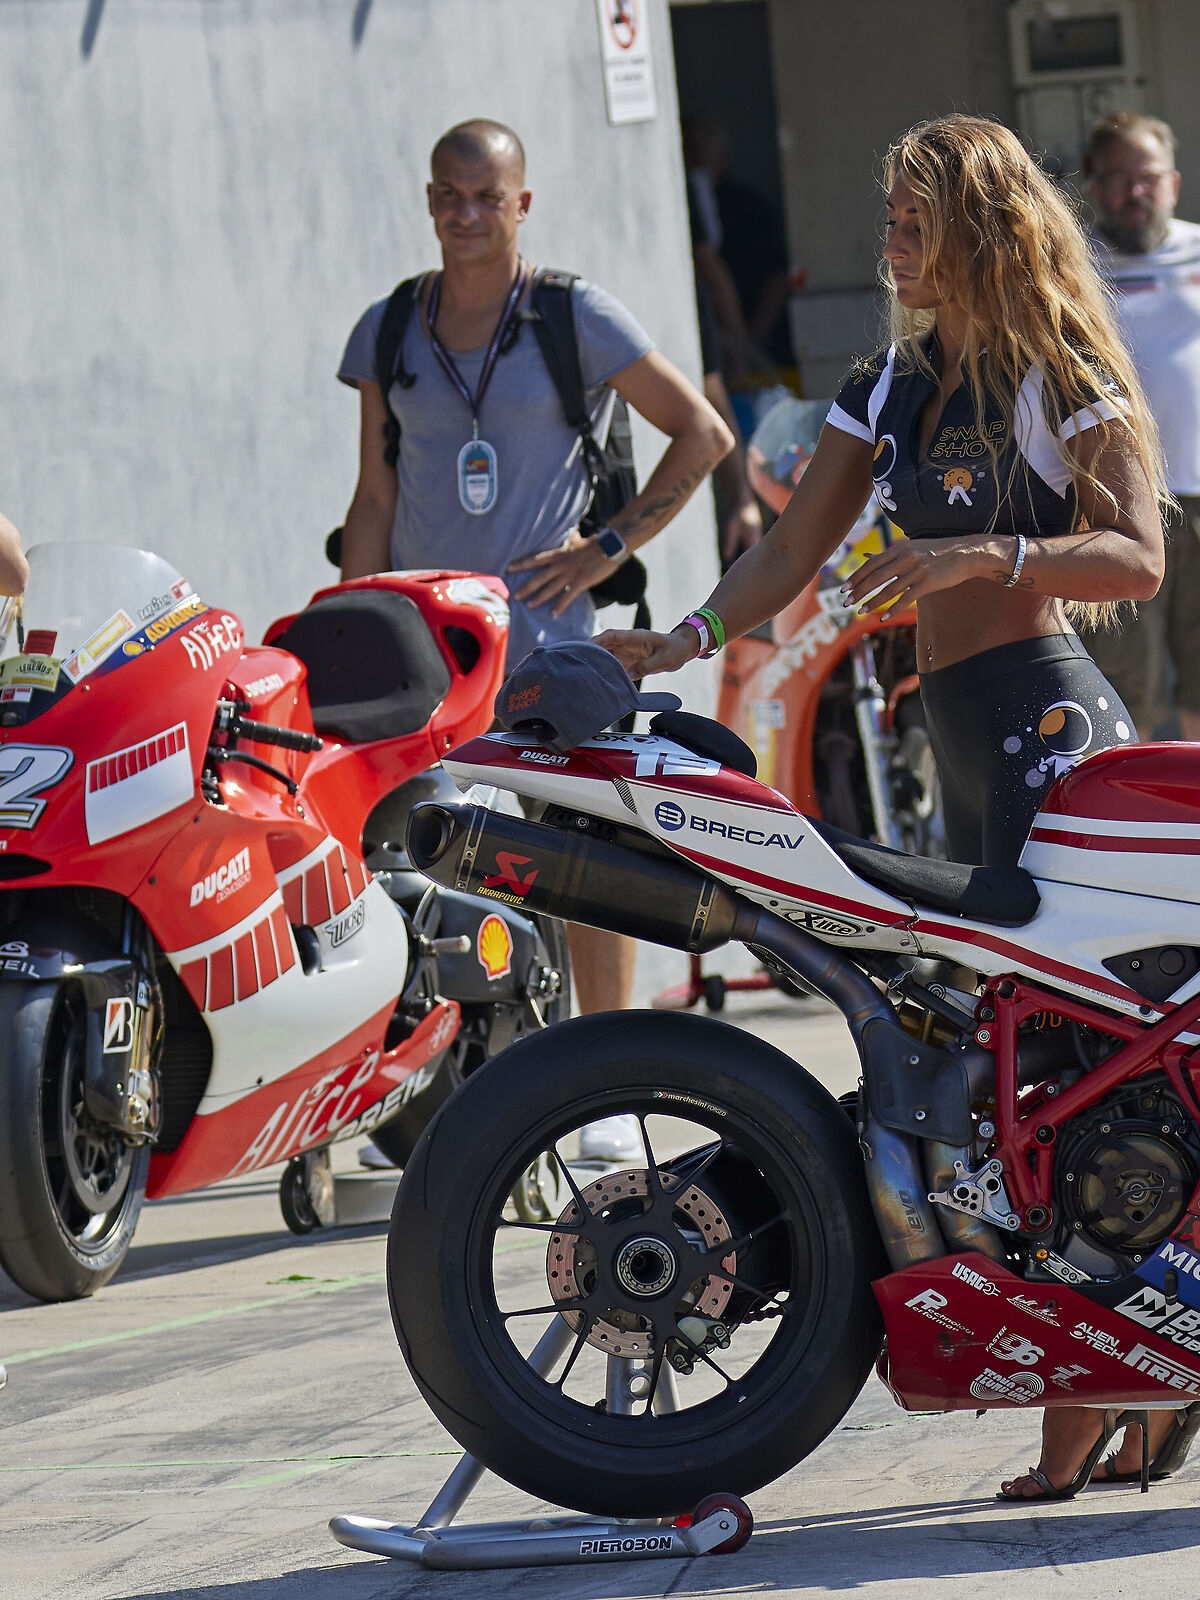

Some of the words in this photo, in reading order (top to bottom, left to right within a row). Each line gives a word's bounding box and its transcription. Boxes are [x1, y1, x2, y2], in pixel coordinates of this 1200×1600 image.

[519, 750, 570, 765] DUCATI
[690, 814, 806, 850] BRECAV
[190, 846, 250, 907] DUCATI
[667, 1093, 708, 1109] marchesini
[951, 1261, 988, 1291] USAG
[1074, 1321, 1120, 1348] ALIEN
[1083, 1335, 1125, 1360] TECH
